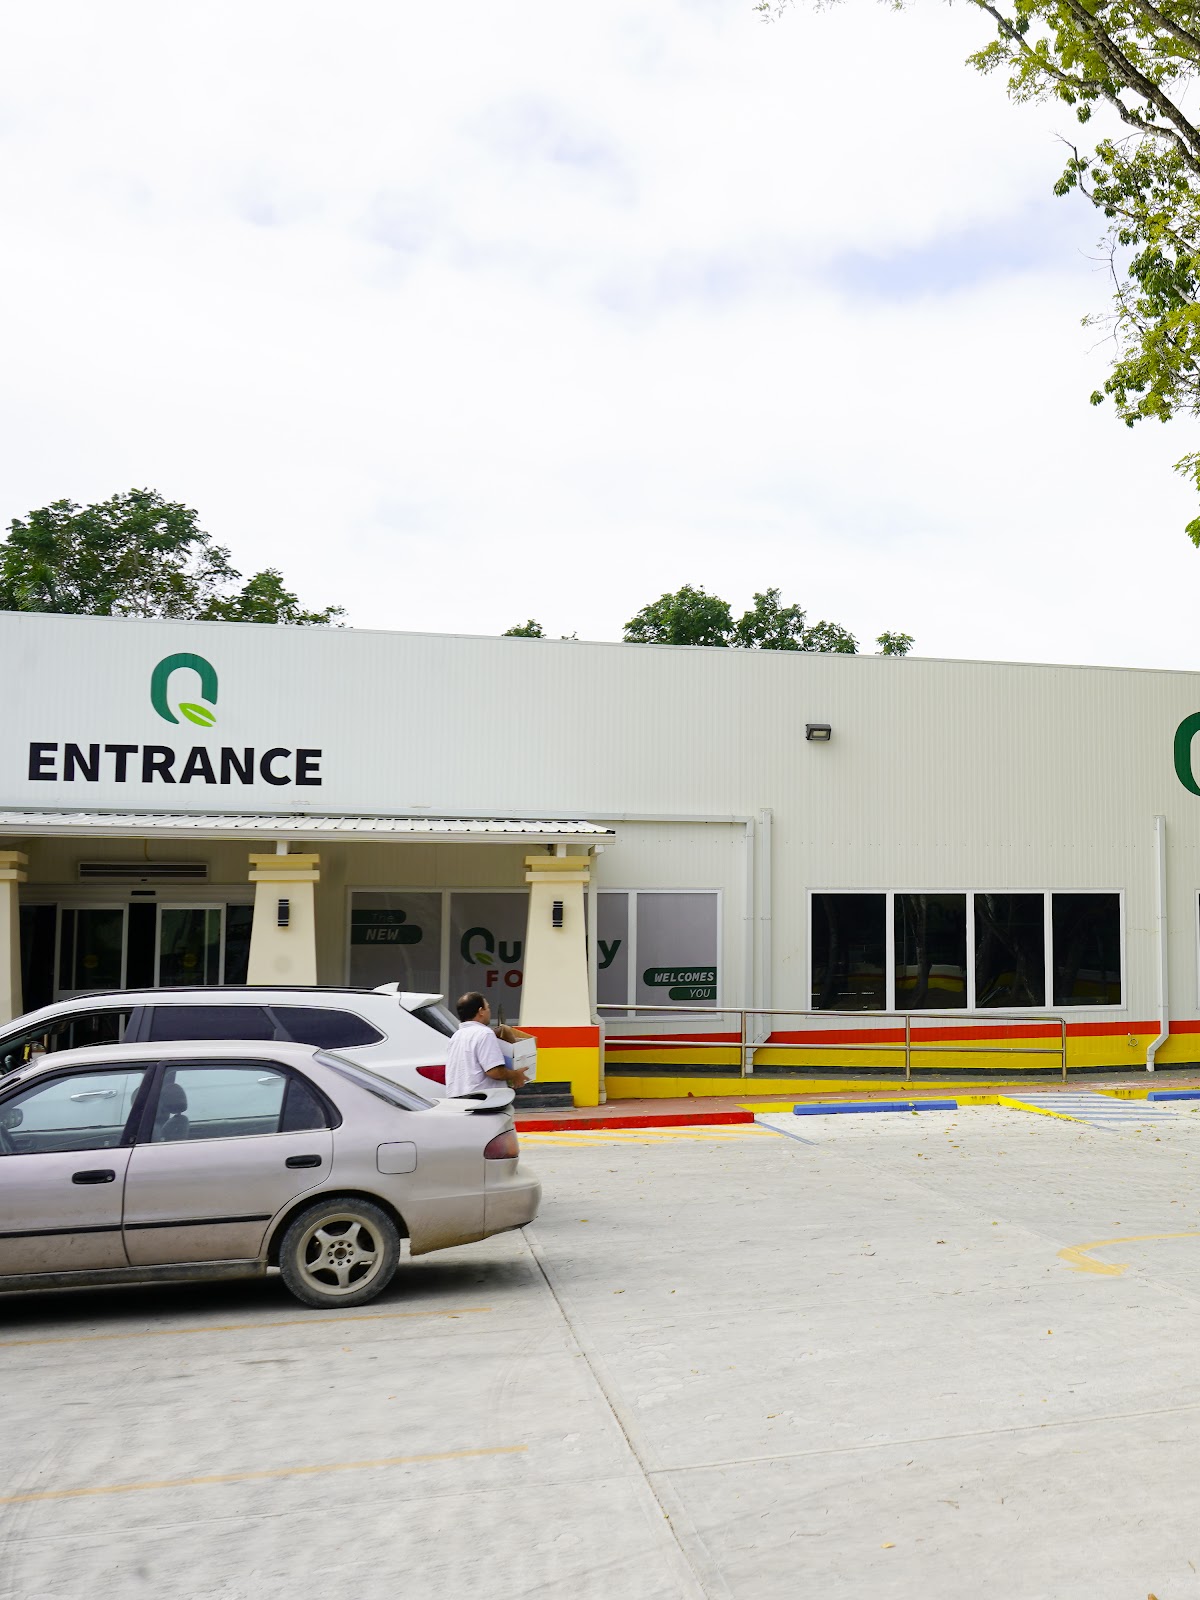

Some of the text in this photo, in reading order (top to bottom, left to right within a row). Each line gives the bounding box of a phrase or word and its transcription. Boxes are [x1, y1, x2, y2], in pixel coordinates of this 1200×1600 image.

[28, 742, 323, 787] ENTRANCE
[372, 913, 395, 923] The
[365, 929, 399, 941] NEW
[654, 972, 714, 983] WELCOMES
[689, 988, 711, 998] YOU
